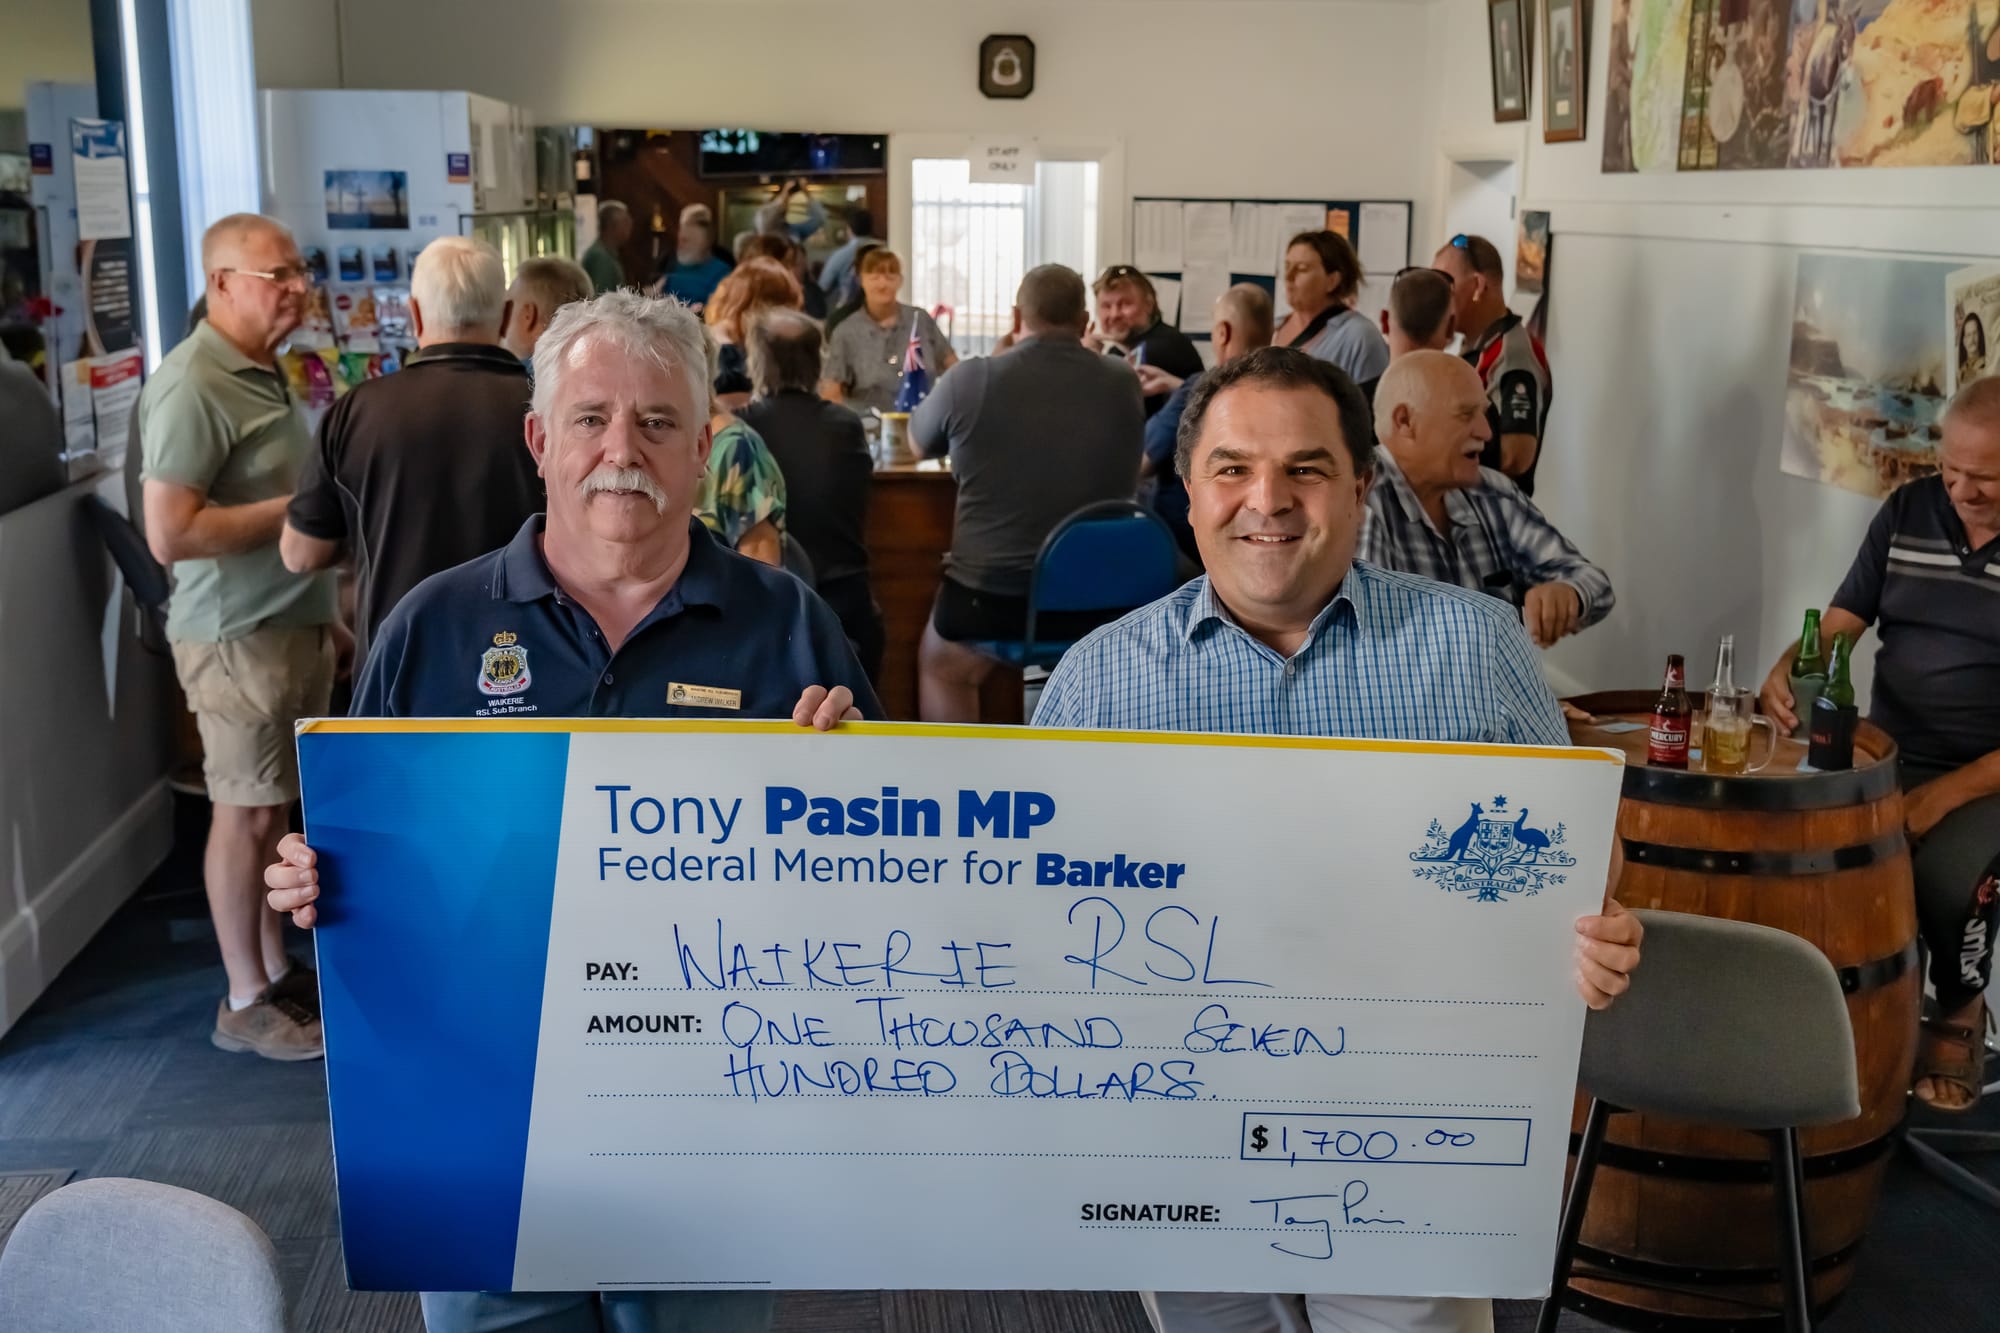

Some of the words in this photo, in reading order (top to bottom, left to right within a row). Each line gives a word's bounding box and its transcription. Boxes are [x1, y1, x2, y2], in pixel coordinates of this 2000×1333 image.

[476, 709, 491, 717] RSL
[492, 707, 508, 715] Sub
[508, 704, 538, 713] Branch
[488, 696, 525, 708] WAIKERIE
[595, 785, 743, 844] Tony
[765, 786, 941, 837] Pasin
[957, 789, 1056, 839] MP
[599, 847, 756, 882] Federal
[774, 849, 948, 884] Member
[963, 850, 1022, 885] for
[1035, 853, 1186, 889] Barker
[1460, 879, 1518, 892] AUSTRALIA
[673, 918, 1017, 990] WAIKERIE
[1064, 896, 1275, 989] RSL
[585, 962, 639, 981] PAY:
[586, 1014, 702, 1034] AMOUNT:
[722, 1001, 835, 1048] ONE
[1184, 1004, 1345, 1056] SEVEN
[724, 1046, 957, 1104] HUNDRED
[1080, 1203, 1221, 1224] SIGNATURE:
